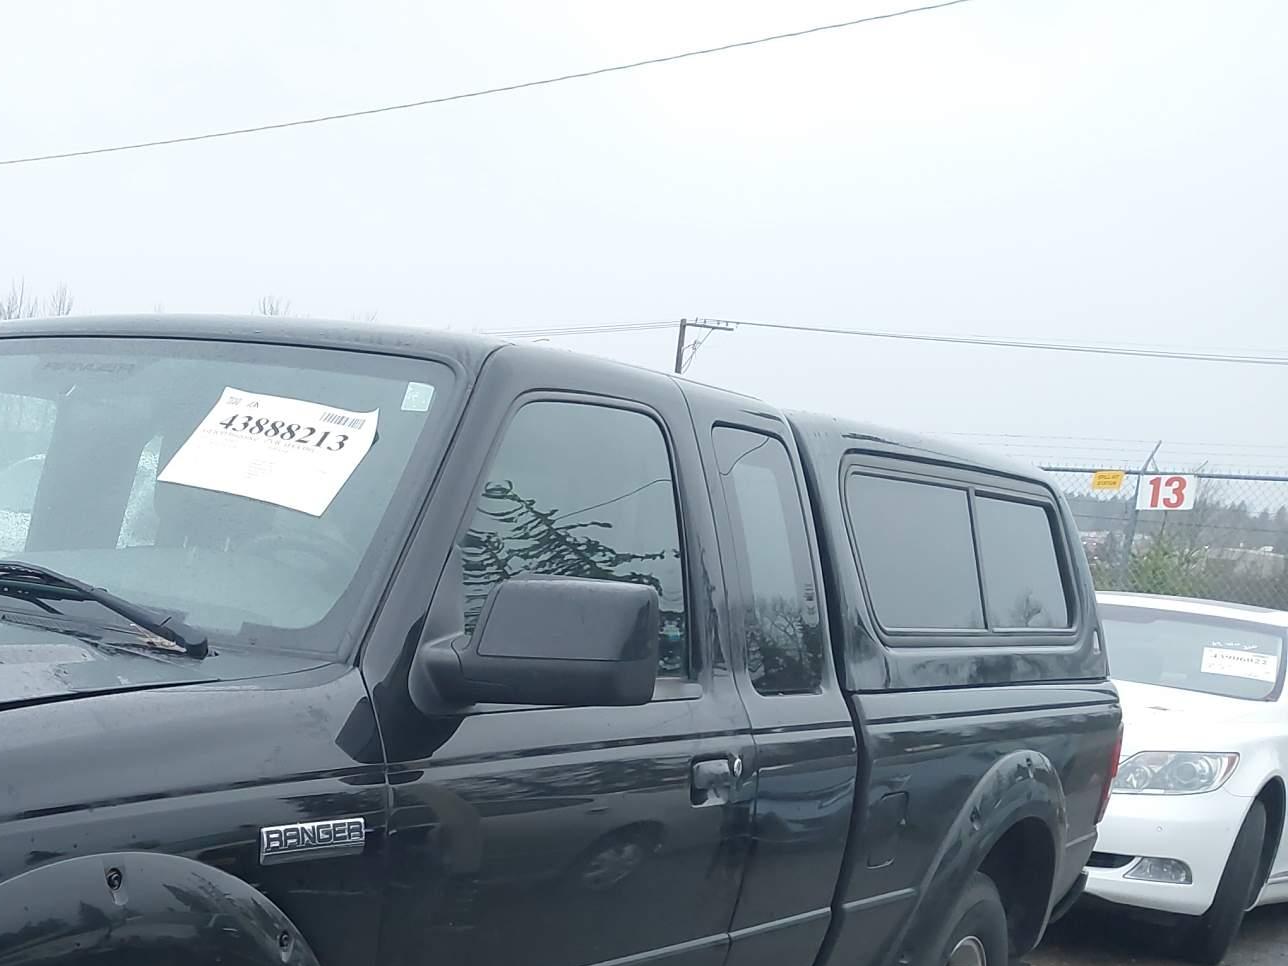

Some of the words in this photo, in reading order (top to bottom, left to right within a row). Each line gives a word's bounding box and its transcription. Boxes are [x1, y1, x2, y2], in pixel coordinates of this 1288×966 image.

[218, 413, 349, 452] 43888213
[1149, 476, 1187, 509] 13
[265, 820, 364, 852] RANGER
